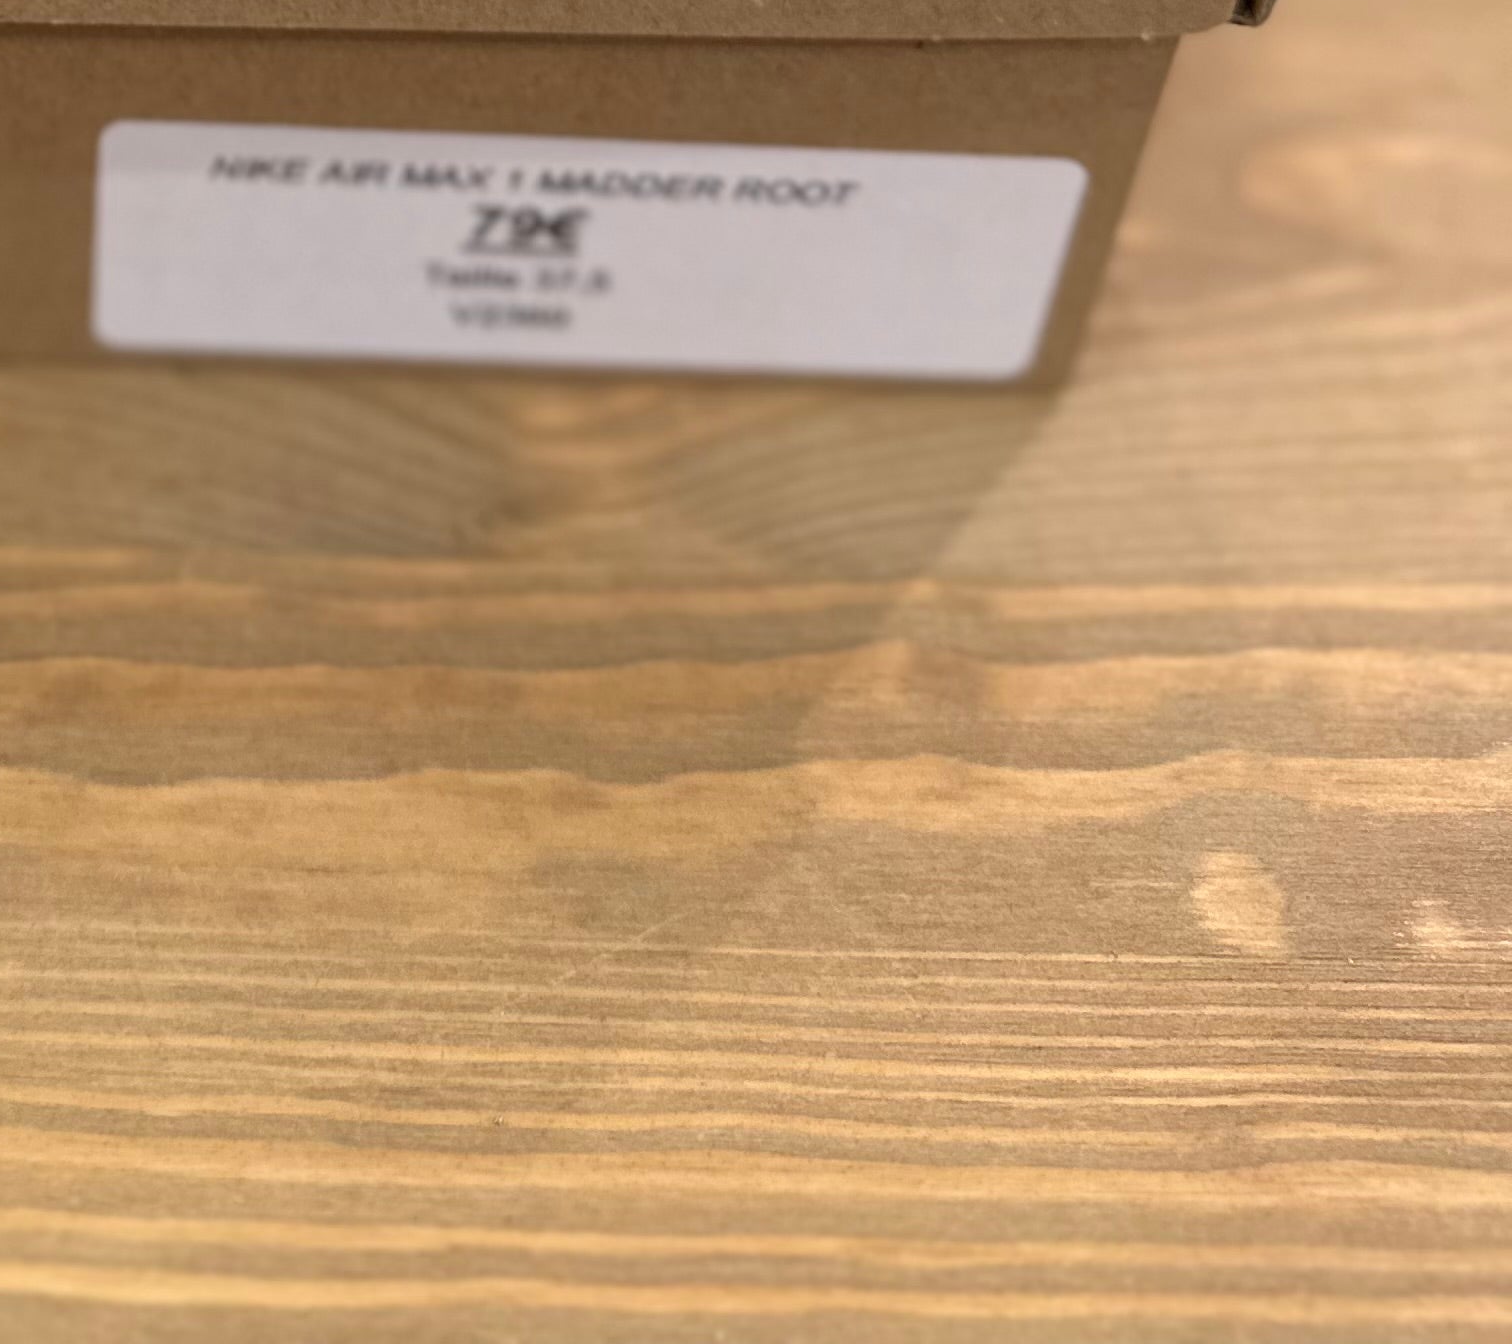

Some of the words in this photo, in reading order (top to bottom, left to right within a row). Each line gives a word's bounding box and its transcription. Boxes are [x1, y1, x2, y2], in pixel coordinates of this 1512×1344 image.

[209, 155, 306, 185] NIKE
[319, 159, 389, 189] AIR
[401, 162, 493, 193] MAX
[508, 167, 524, 192] 1
[538, 168, 723, 201] MADDER
[734, 174, 862, 207] ROOT
[466, 202, 592, 250] 79€
